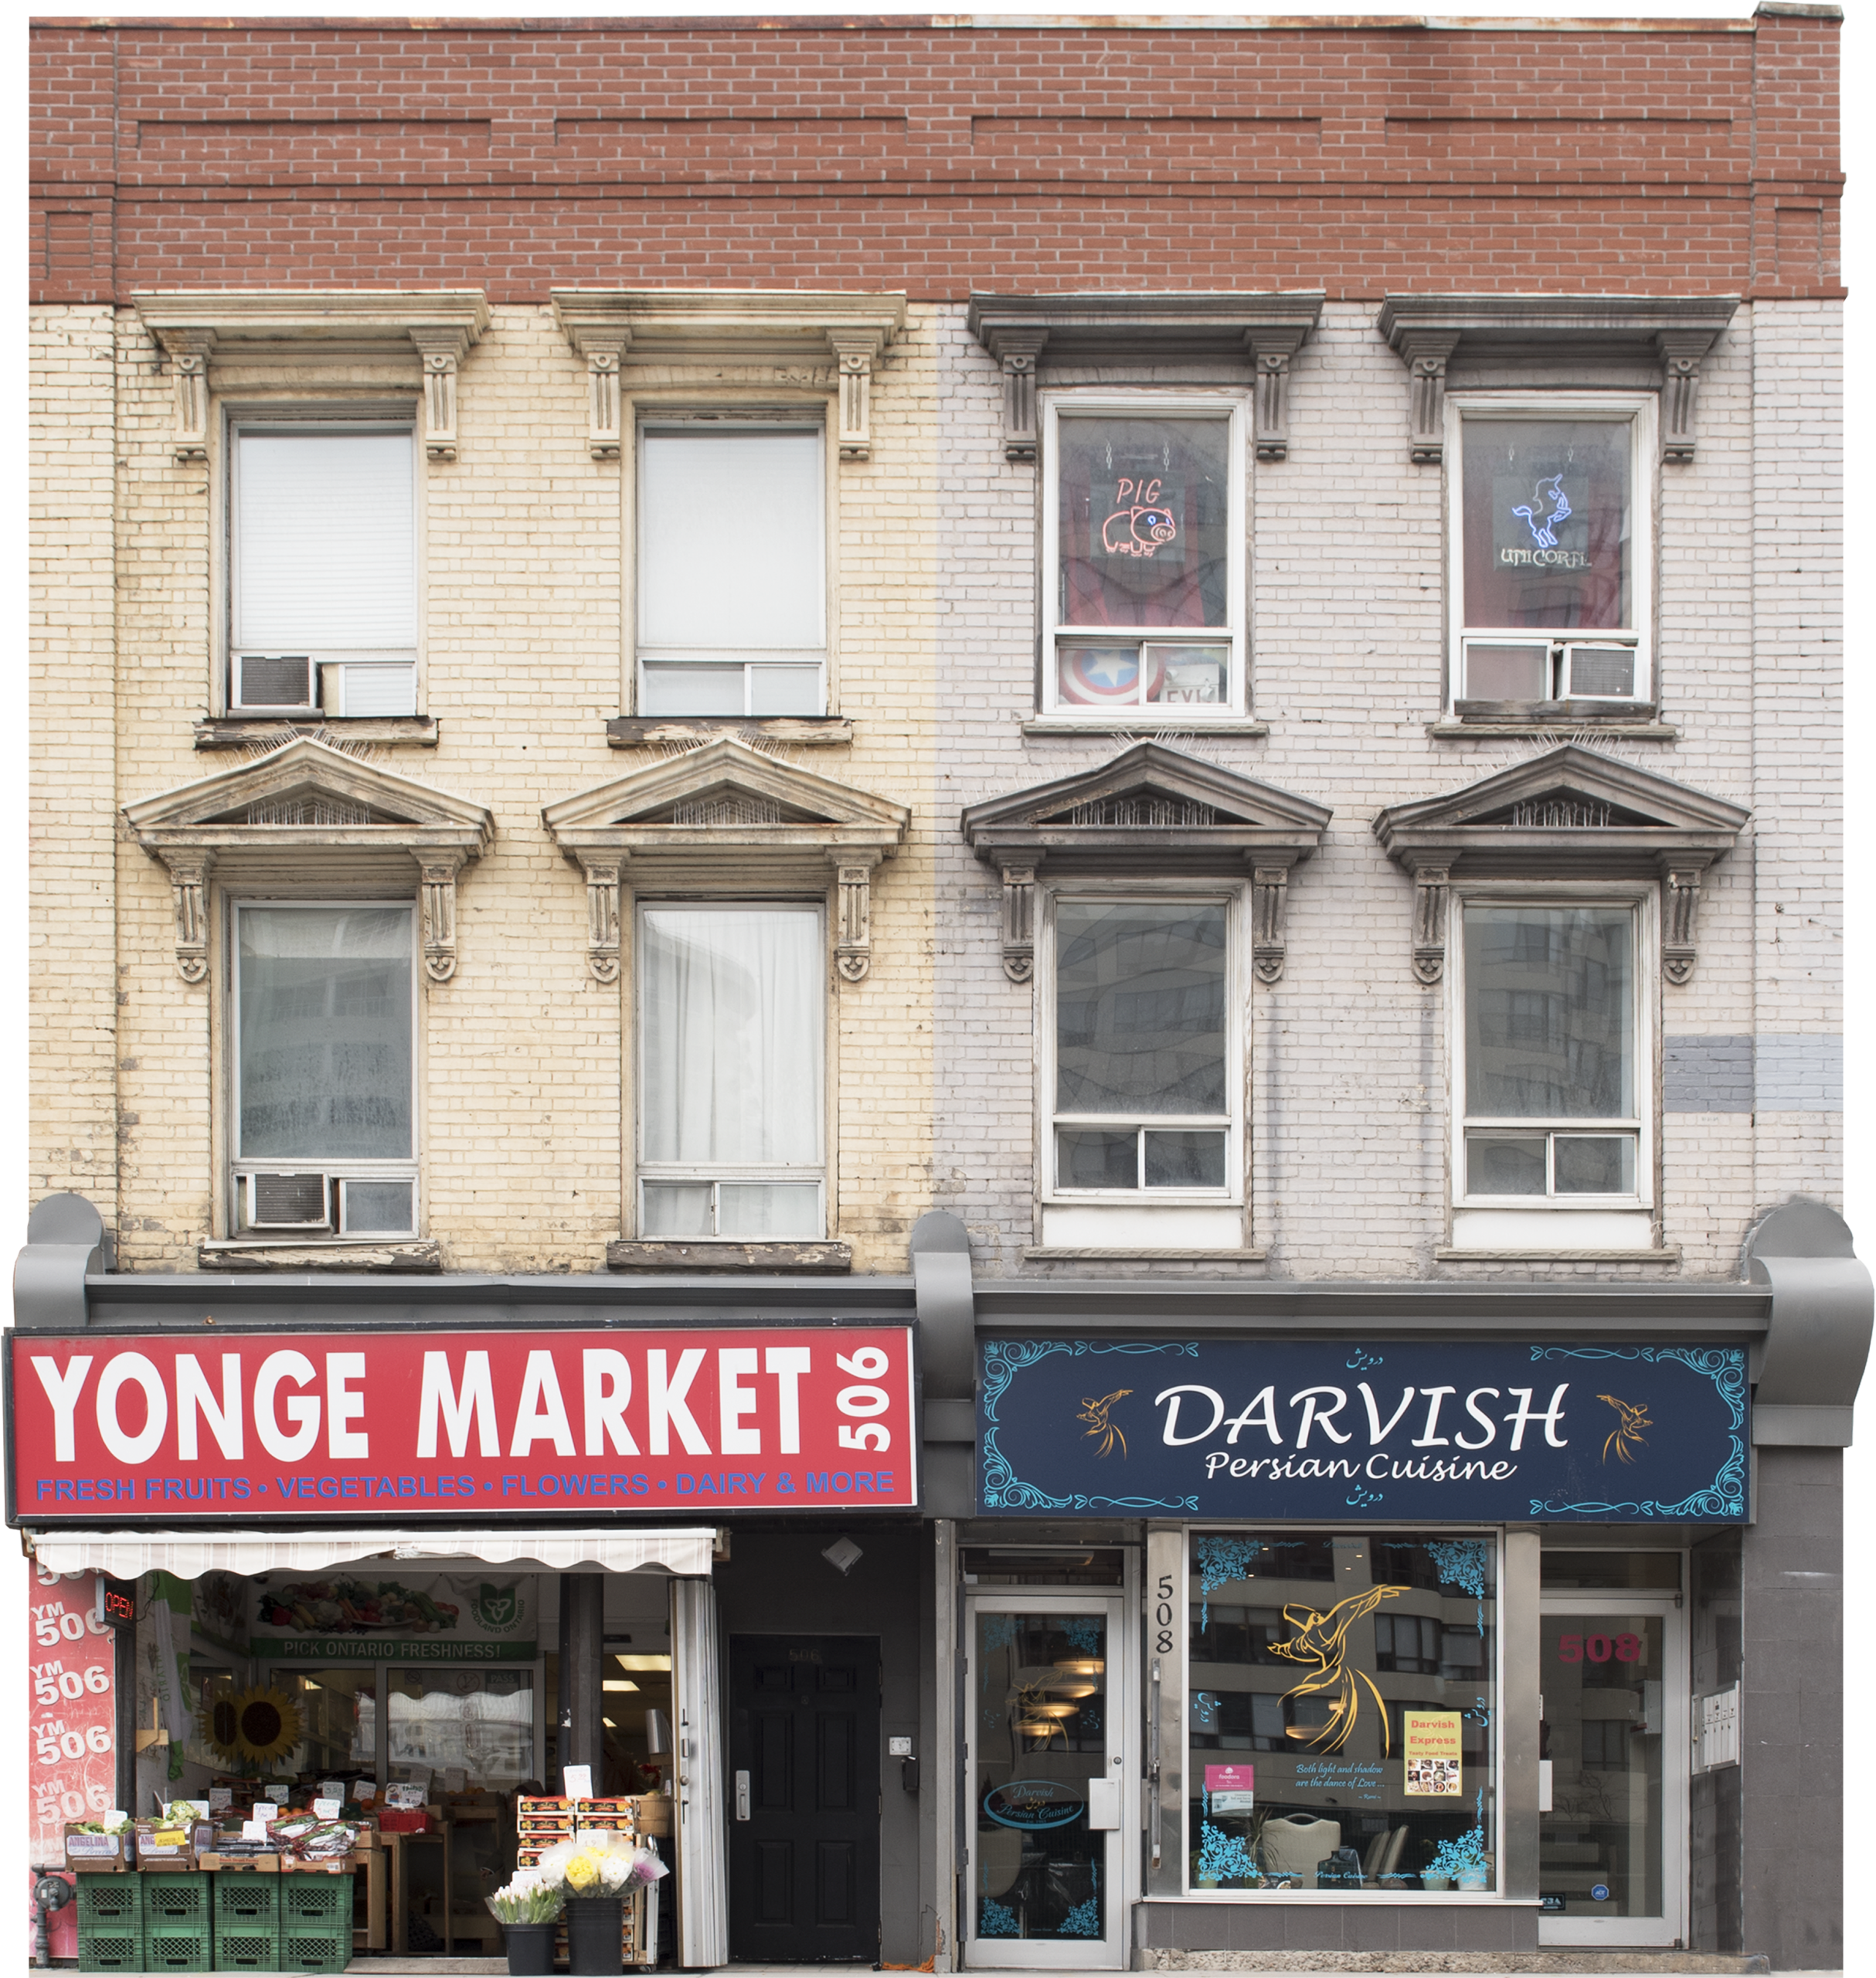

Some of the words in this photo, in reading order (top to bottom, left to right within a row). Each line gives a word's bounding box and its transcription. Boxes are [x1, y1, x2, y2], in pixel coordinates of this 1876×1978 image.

[1116, 478, 1162, 505] PIG
[30, 1350, 369, 1465] YONGE
[417, 1347, 811, 1458] MARKET
[837, 1347, 891, 1453] 506
[1155, 1382, 1570, 1451] DARVISH
[1205, 1452, 1361, 1480] Persian
[1365, 1453, 1517, 1482] Cuisine
[37, 1479, 134, 1500] FRESH
[146, 1477, 251, 1500] FRUITS
[277, 1476, 475, 1498] VEGETABLES
[502, 1473, 649, 1496] FLOWERS
[676, 1473, 766, 1494] DAIRY
[777, 1472, 796, 1494] &
[807, 1471, 895, 1493] MORE
[30, 1601, 65, 1620] YM
[471, 1598, 502, 1634] FOODLAND
[503, 1599, 525, 1633] ONTARIO
[1156, 1575, 1174, 1654] 508
[36, 1607, 110, 1647] 506
[284, 1640, 320, 1656] PICK
[325, 1640, 395, 1657] ONTARIO
[400, 1641, 501, 1659] FRESHNESS!
[789, 1648, 820, 1662] 506
[1558, 1633, 1641, 1663] 508
[29, 1660, 64, 1680] YM
[491, 1674, 515, 1684] PASS
[34, 1665, 110, 1705] 506
[31, 1719, 66, 1739] YM
[1411, 1720, 1455, 1728] Darvish
[36, 1725, 112, 1766] 506
[1410, 1735, 1456, 1745] Express
[1296, 1762, 1317, 1773] Both
[1317, 1762, 1337, 1778] light
[1337, 1762, 1354, 1773] and
[1354, 1762, 1383, 1774] shadow
[31, 1779, 66, 1798] YM
[1012, 1784, 1055, 1799] Darvish
[1310, 1776, 1322, 1787] the
[1324, 1776, 1346, 1787] dance
[1348, 1777, 1358, 1789] of
[36, 1784, 112, 1825] 506
[997, 1803, 1035, 1819] Persian
[1037, 1805, 1074, 1820] Cuisine
[69, 1836, 109, 1847] ANGELINA
